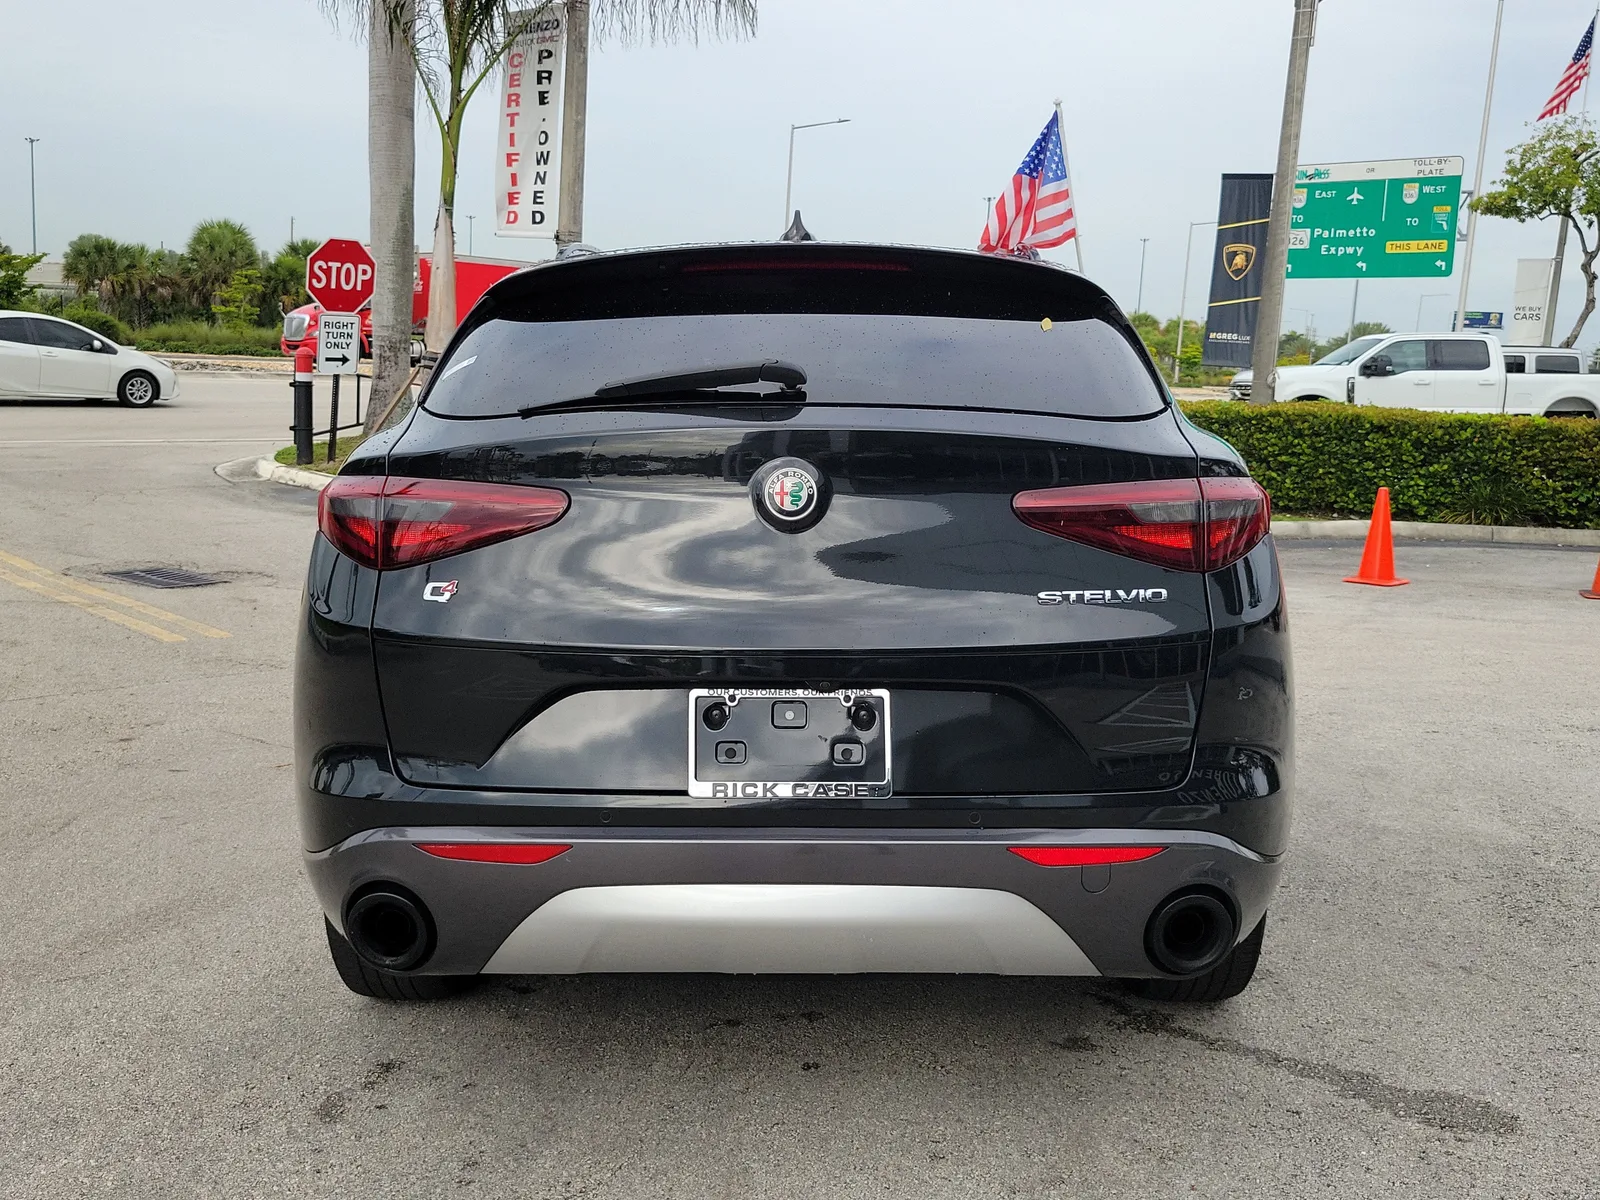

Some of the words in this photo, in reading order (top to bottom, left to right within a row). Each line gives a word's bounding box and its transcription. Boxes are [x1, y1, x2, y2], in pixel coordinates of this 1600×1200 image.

[506, 53, 523, 225] CERTIFIED
[1422, 185, 1446, 193] WEST
[1315, 190, 1336, 198] EAST
[1406, 218, 1419, 226] TO
[1314, 227, 1376, 238] Palmetto
[1321, 245, 1364, 256] Expwy
[1417, 242, 1444, 250] LANE
[311, 260, 372, 291] STOP
[1513, 313, 1541, 321] CARS
[324, 321, 355, 330] RIGHT
[325, 331, 353, 339] TURN
[325, 341, 352, 349] ONLY
[769, 474, 784, 494] ALFA
[788, 471, 814, 494] ROMEO
[1037, 588, 1168, 605] STELVIO
[707, 688, 731, 697] OUR
[712, 783, 779, 798] RICK
[791, 783, 869, 798] CASE
